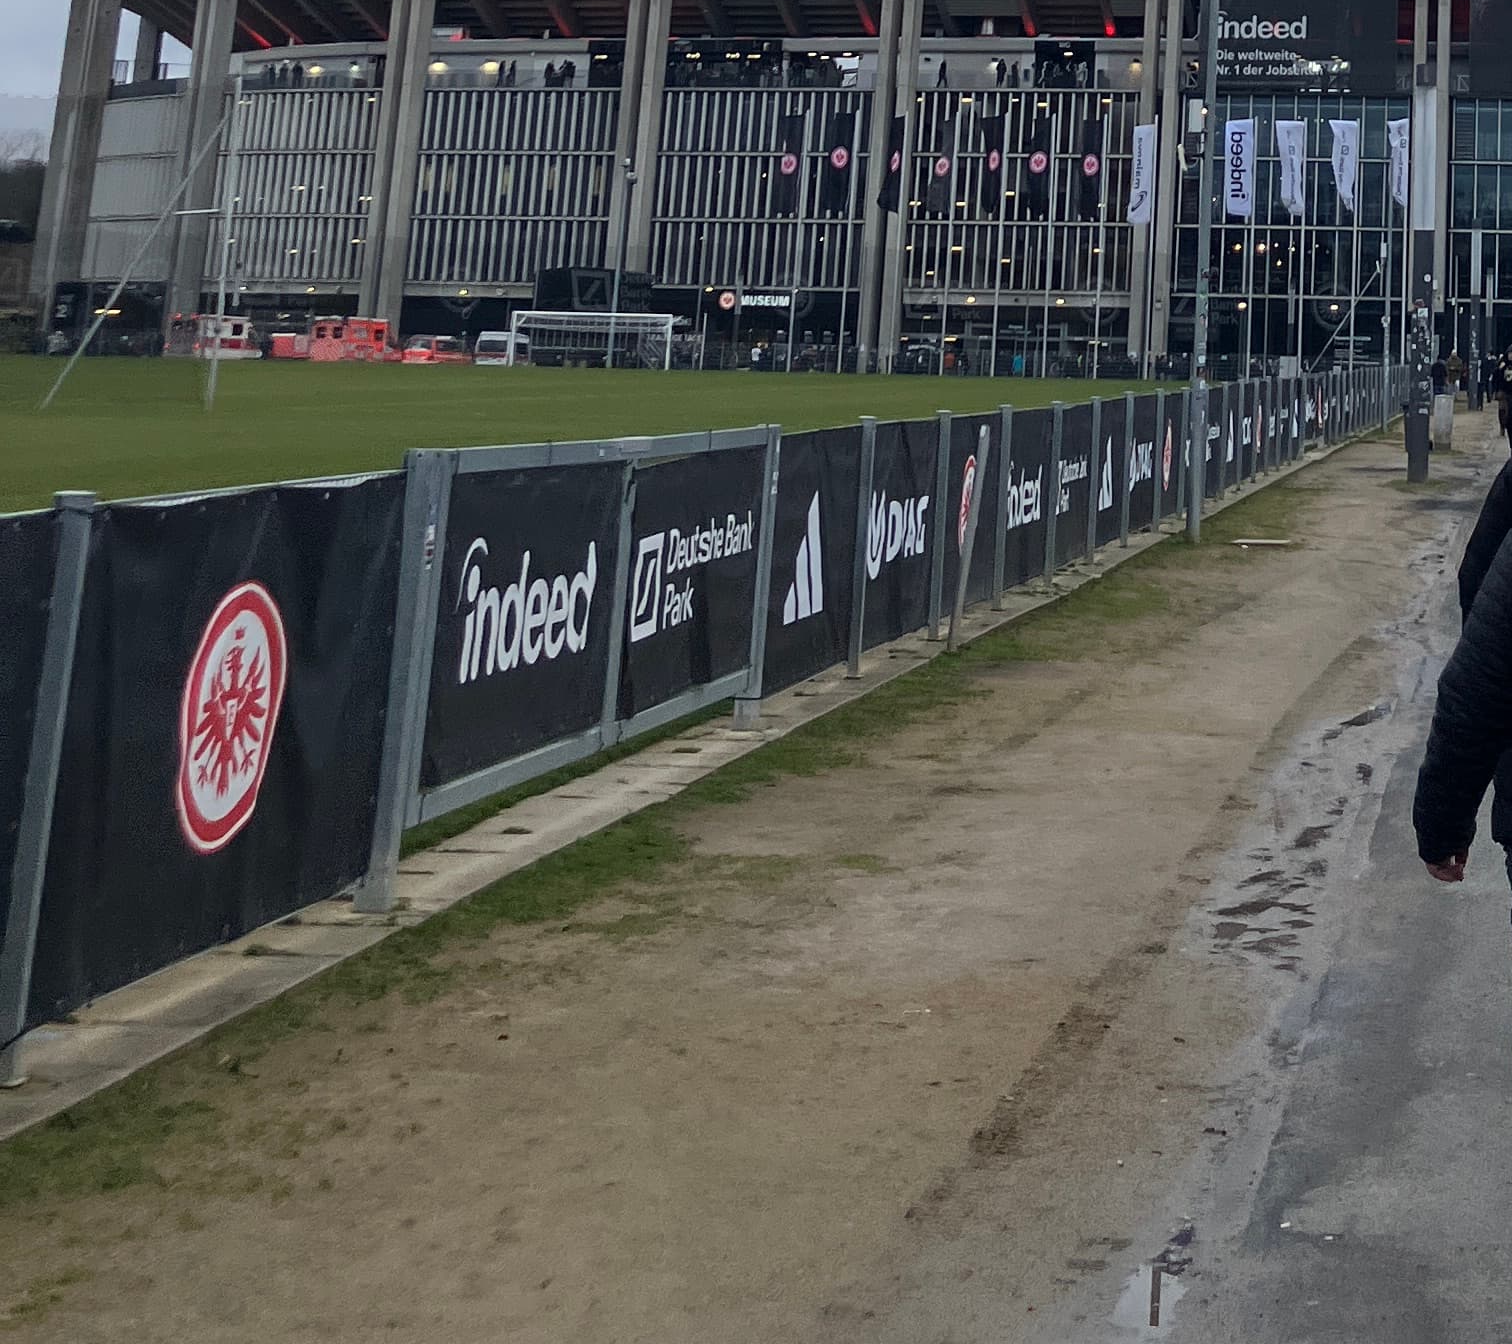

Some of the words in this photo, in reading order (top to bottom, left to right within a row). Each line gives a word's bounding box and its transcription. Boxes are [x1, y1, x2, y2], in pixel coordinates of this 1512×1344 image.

[1217, 10, 1307, 40] indeed
[1216, 48, 1235, 61] Die
[1216, 64, 1232, 76] Nr.
[1234, 63, 1240, 76] 1
[1242, 63, 1264, 76] der
[740, 295, 790, 306] MUSEUM
[456, 536, 597, 685] indeed
[662, 576, 695, 630] Park
